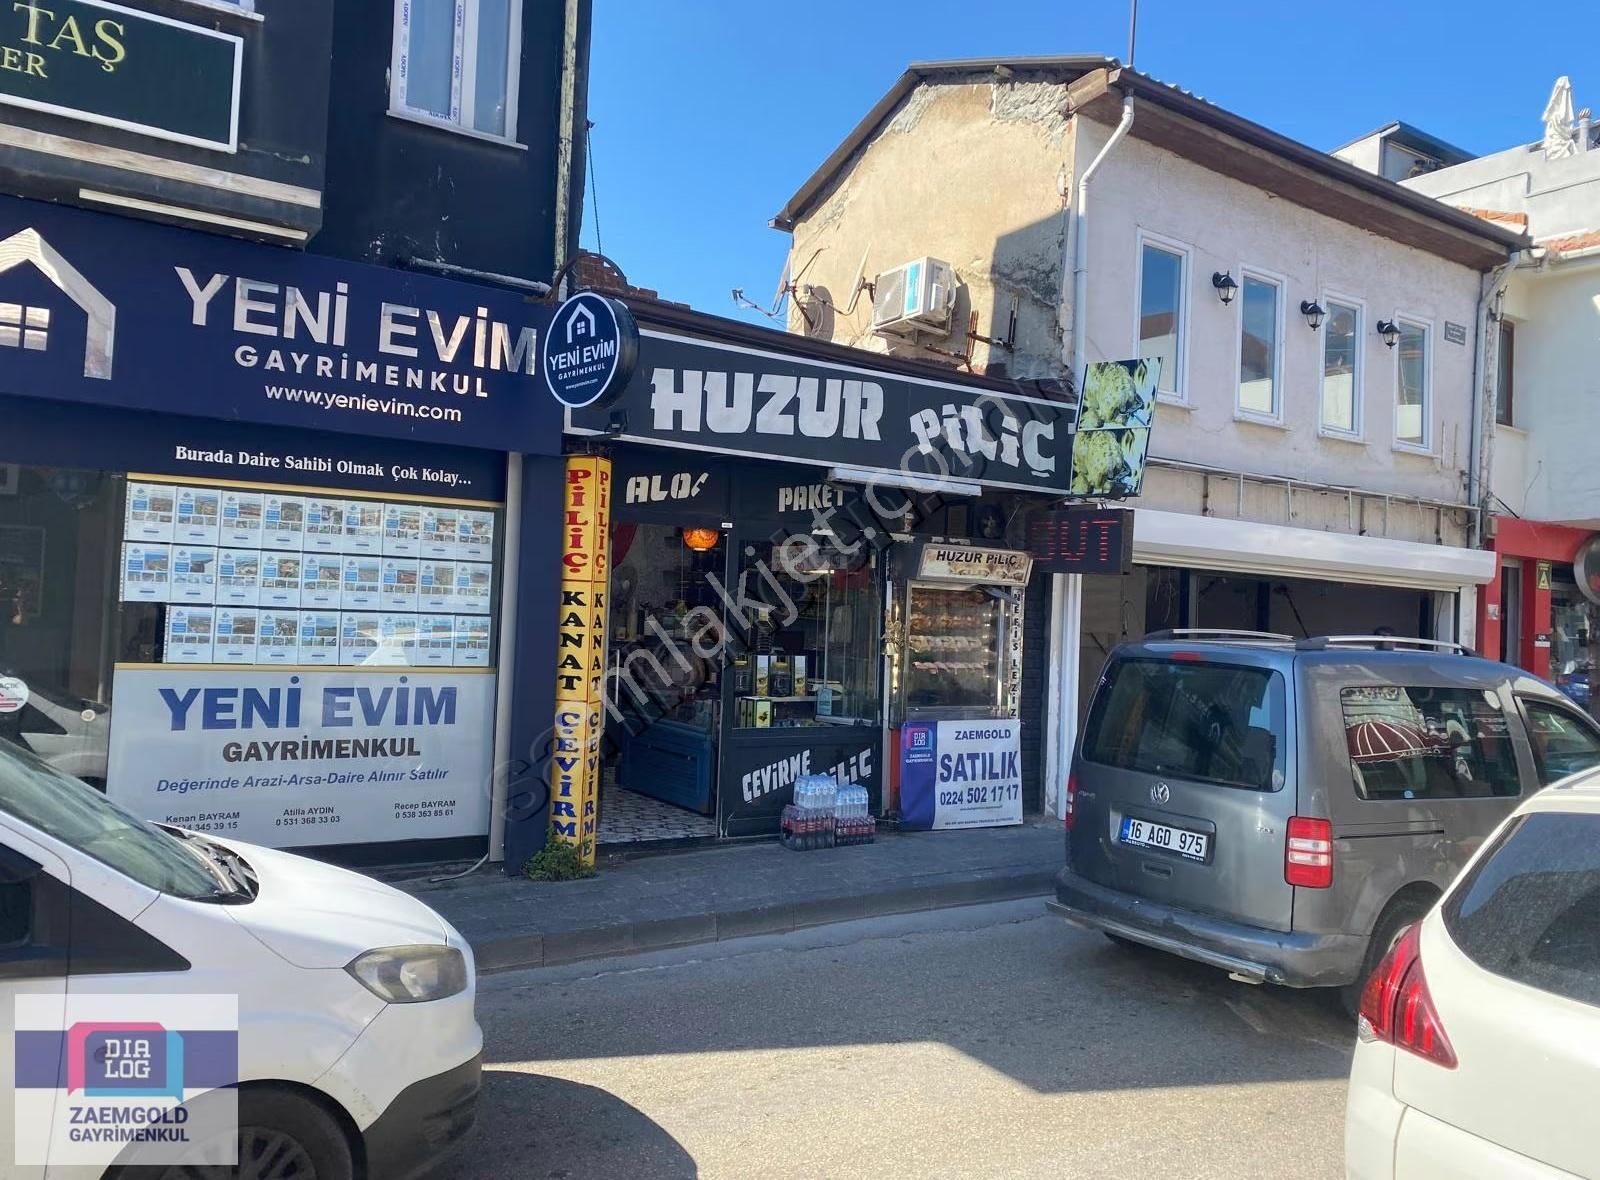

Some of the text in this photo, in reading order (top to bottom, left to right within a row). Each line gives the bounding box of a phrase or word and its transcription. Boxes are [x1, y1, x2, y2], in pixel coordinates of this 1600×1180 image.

[13, 2, 126, 73] TAŞ
[0, 46, 49, 79] ER
[174, 265, 537, 376] YENİ EVİM
[234, 344, 489, 398] GAYRİMENKUL
[549, 338, 615, 371] YENİ EVİM
[558, 362, 606, 380] GAYRİMENKUL
[264, 385, 463, 422] www.yenievim.com
[650, 367, 1056, 478] HUZUR PİLİÇ
[175, 446, 472, 487] Burada Daire Sahibi Olmak Çok Kolay...
[625, 472, 692, 504] ALO
[778, 484, 844, 513] PAKET
[936, 550, 1018, 566] HUZUR PİLİÇ
[551, 468, 592, 849] PİLİÇ KANAT ÇEVİRM
[582, 470, 609, 857] PİLİÇ KANAT ÇEVİRME
[158, 675, 457, 731] YENİ EVİM
[1010, 661, 1018, 717] LEZİZ
[222, 735, 422, 763] GAYRİMENKUL
[954, 729, 1011, 741] ZAEMGOLD
[156, 768, 449, 794] Değerinde Arazi-Arsa-Daire Alınır Satılır
[742, 749, 811, 804] ÇEVİRME
[824, 748, 872, 786] İLİÇ
[939, 750, 1019, 783] SATILIK
[307, 806, 335, 815] AYDIN
[394, 800, 456, 811] Recep BAYRAM
[940, 784, 1019, 806] 0224 502 17 17
[166, 811, 240, 823] Kenan BAYRAM
[195, 823, 211, 831] 345
[213, 822, 225, 830] 39
[228, 821, 238, 829] 15
[275, 818, 281, 826] 0
[283, 817, 299, 826] 531
[318, 816, 329, 824] 33
[330, 815, 341, 823] 03
[395, 811, 400, 819] 0
[402, 811, 416, 819] 538
[418, 810, 432, 818] 363
[1130, 821, 1143, 839] 16
[1147, 825, 1172, 846] AGD
[1178, 832, 1204, 854] 975
